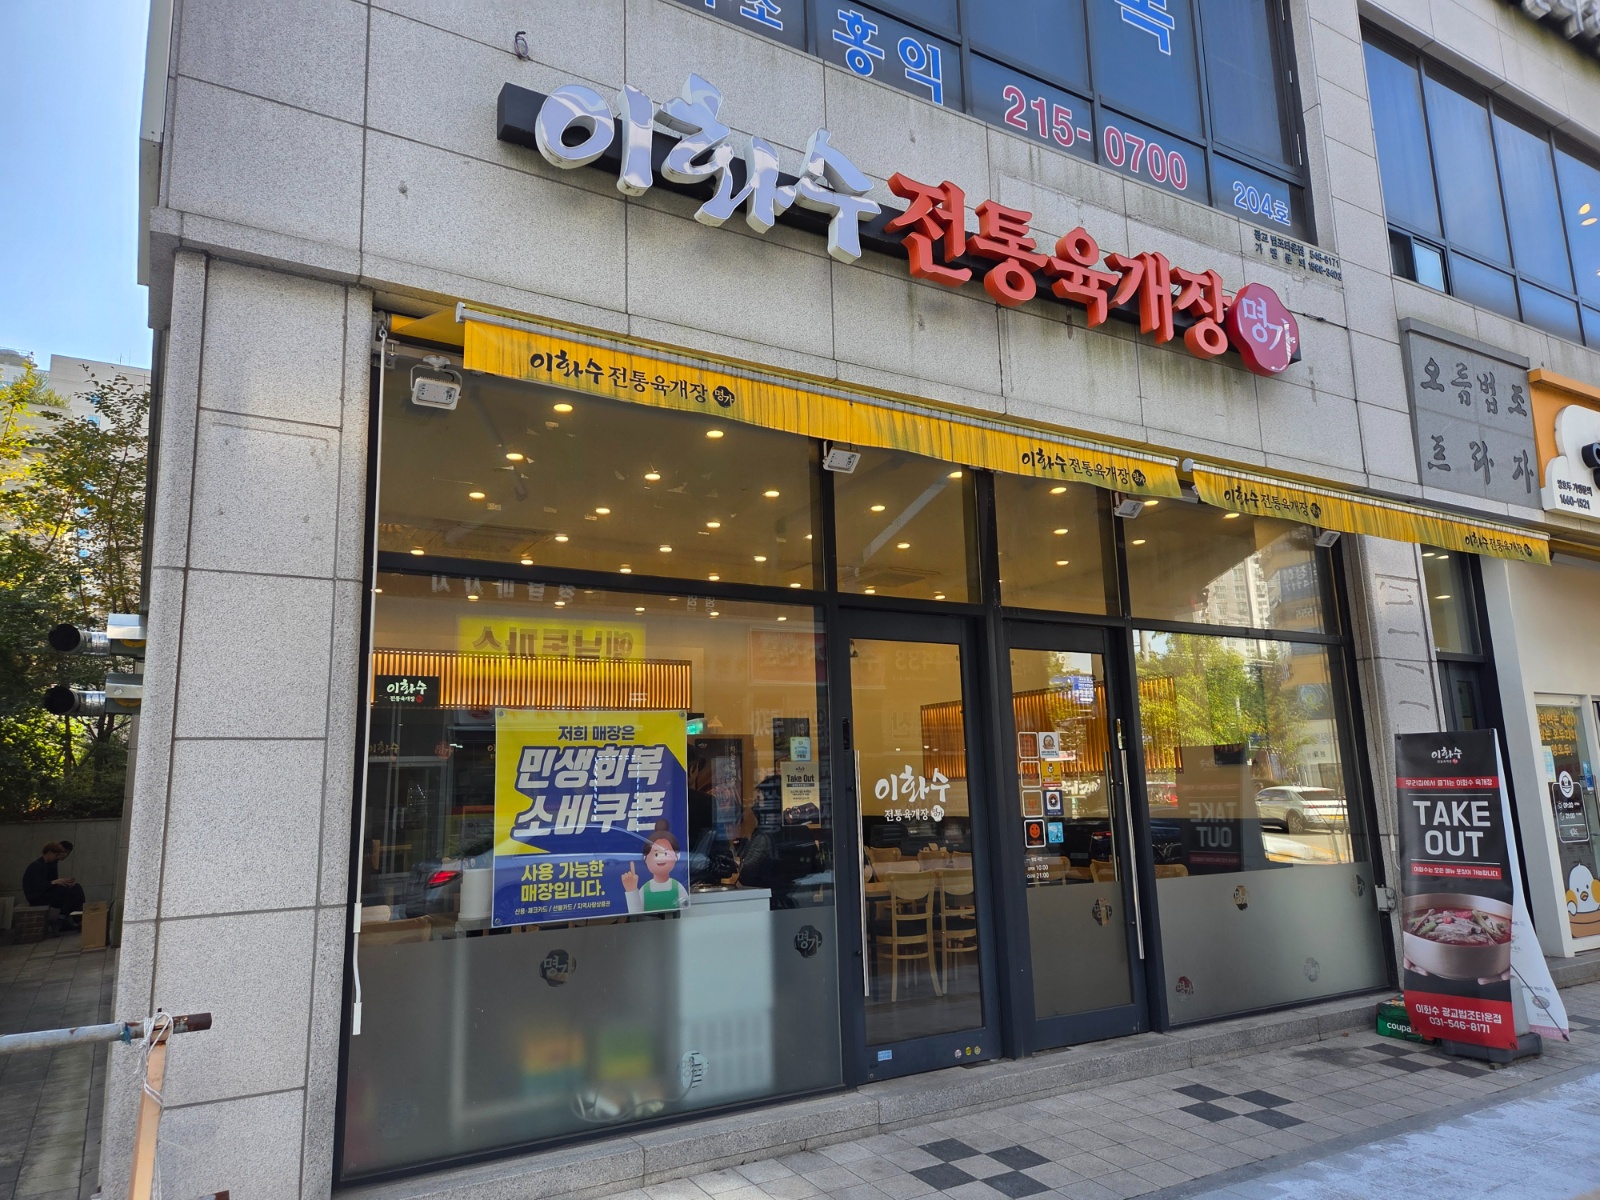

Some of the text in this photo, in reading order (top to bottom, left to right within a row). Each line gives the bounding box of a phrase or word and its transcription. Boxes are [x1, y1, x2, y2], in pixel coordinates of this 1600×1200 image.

[1002, 85, 1188, 190] 215-0700
[535, 73, 1296, 361] 이화수 전통육개장 명가
[1232, 181, 1291, 227] 204호
[529, 349, 604, 384] 이화수
[607, 365, 708, 403] 전통육개장
[1021, 448, 1067, 473] 이화수
[1069, 457, 1130, 486] 전통육개장
[1224, 485, 1260, 509] 이화수
[1260, 493, 1309, 517] 전통육개장
[386, 678, 428, 695] 이화수
[557, 725, 635, 742] 저희 매장은
[1431, 746, 1463, 759] 이화수
[517, 746, 664, 789] 민생회복
[787, 773, 815, 783] Take Out
[875, 764, 951, 803] 이화수
[1405, 778, 1492, 787] 우리집에서 즐기는 이화수 육개장
[512, 791, 666, 837] 소비쿠폰
[884, 808, 929, 822] 전통육개장
[1412, 800, 1491, 827] TAKE
[1424, 831, 1484, 857] OUT
[520, 859, 604, 882] 사용 가능한
[520, 879, 606, 902] 매장입니다.
[1415, 1003, 1502, 1024] 이화수 광교법조타운점
[1429, 1016, 1490, 1034] 031-546-8171
